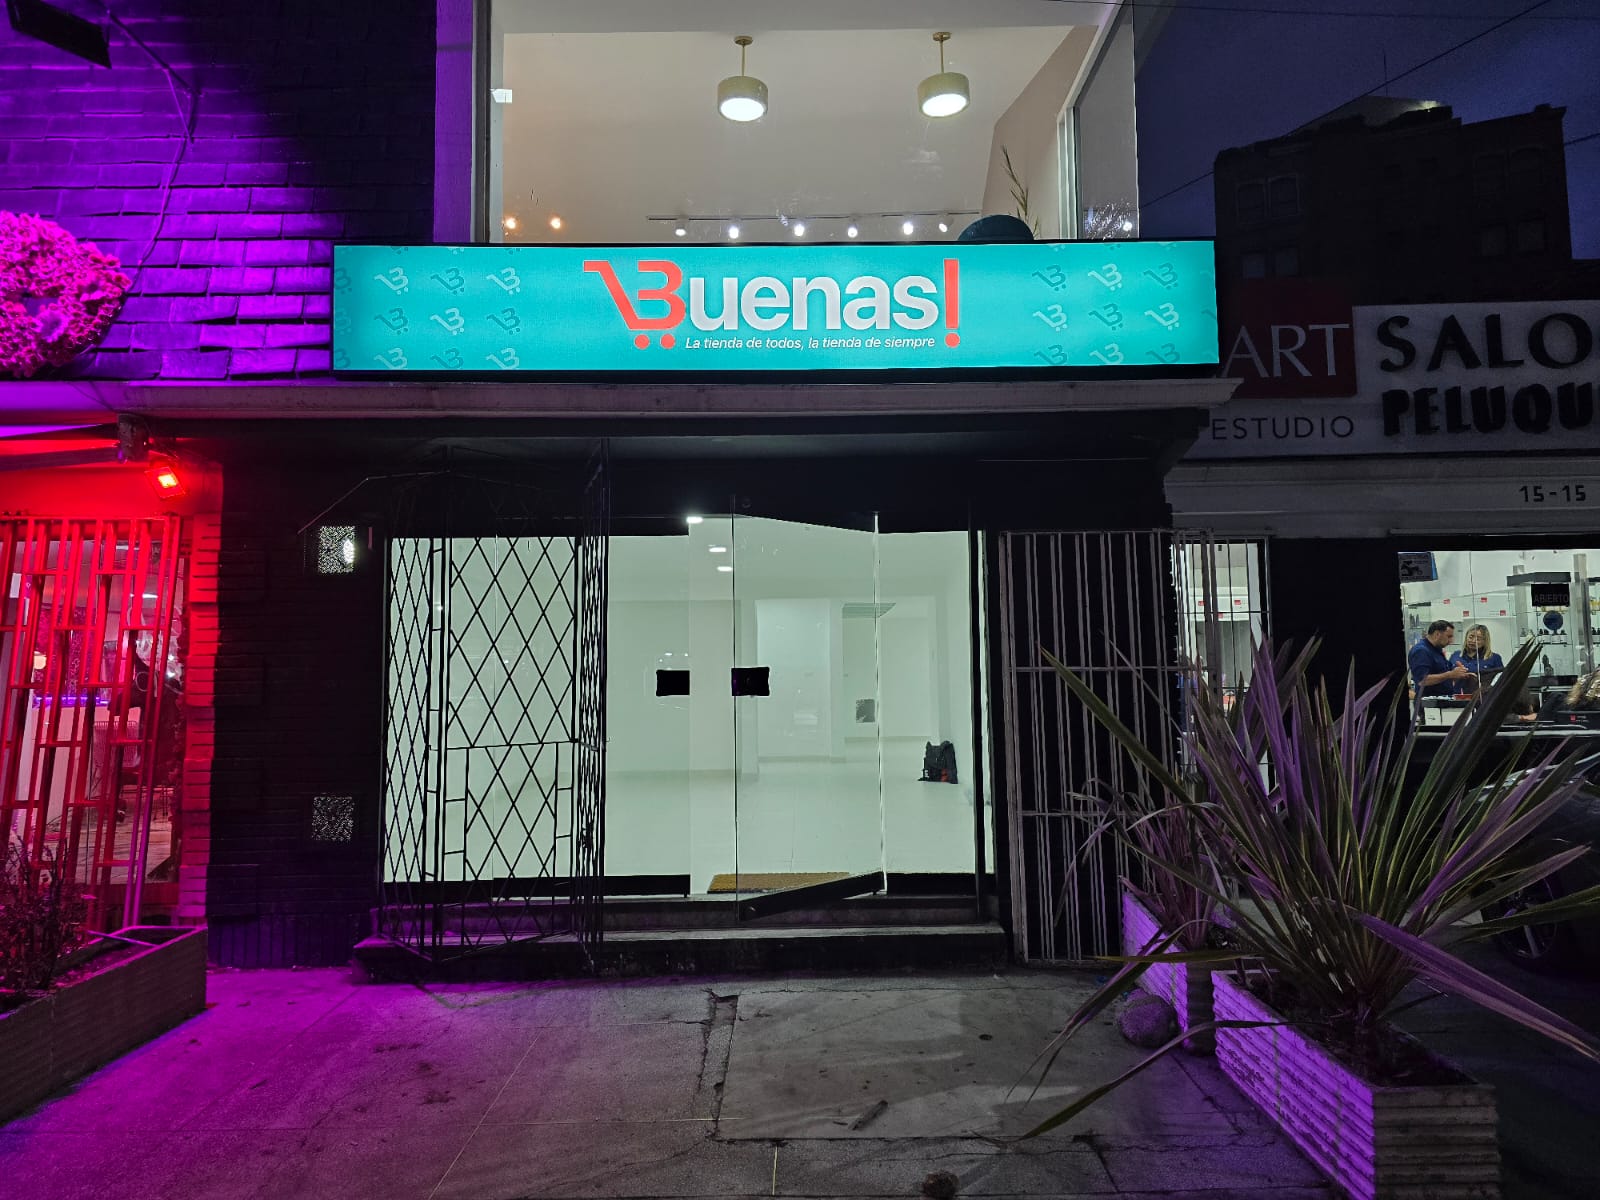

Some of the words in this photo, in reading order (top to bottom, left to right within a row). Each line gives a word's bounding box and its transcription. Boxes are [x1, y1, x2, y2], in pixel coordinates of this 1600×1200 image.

[584, 258, 961, 350] Buenas!
[685, 337, 700, 349] La
[704, 337, 744, 349] tienda
[746, 337, 763, 349] de
[766, 337, 805, 350] todos,
[808, 337, 819, 349] la
[822, 337, 861, 349] tienda
[865, 337, 882, 349] de
[884, 336, 935, 349] siempre
[1220, 322, 1350, 379] ART
[1377, 311, 1600, 373] SALO
[1211, 415, 1354, 442] ESTUDIO
[1382, 381, 1600, 437] PELUQU
[1519, 484, 1587, 502] 15-15
[1534, 593, 1569, 603] ABIERTO
